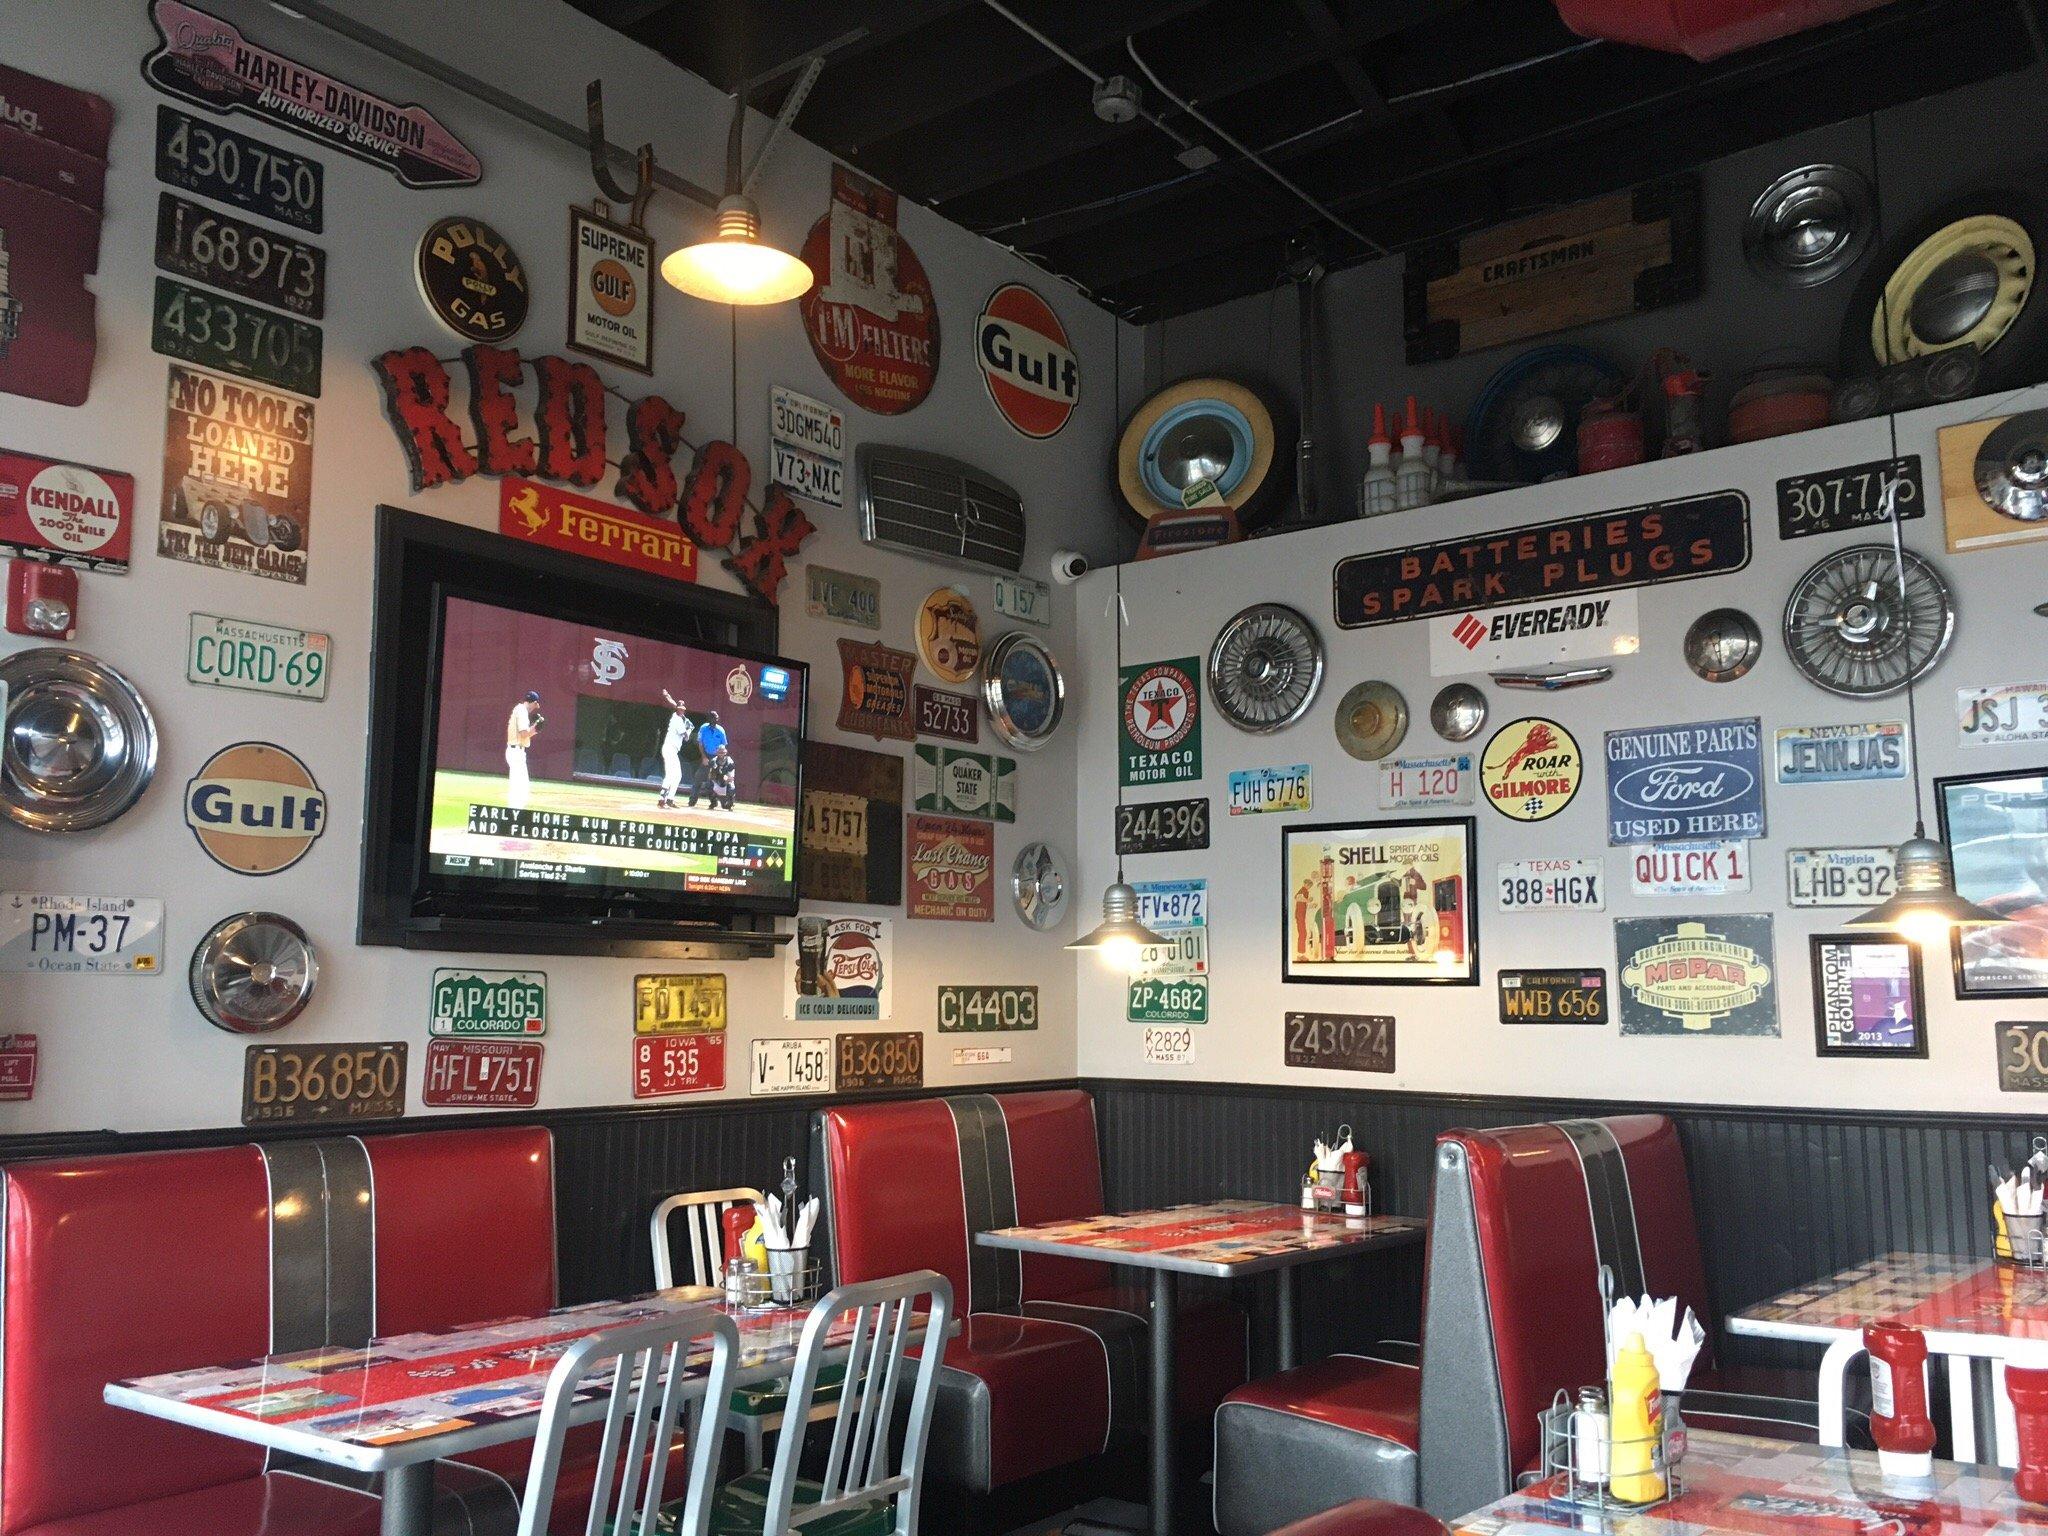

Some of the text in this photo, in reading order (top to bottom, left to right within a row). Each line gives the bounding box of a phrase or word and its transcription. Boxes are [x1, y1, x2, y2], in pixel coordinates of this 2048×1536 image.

[177, 22, 233, 53] Quality
[235, 48, 426, 150] HARLEY-DAVIDSON
[257, 86, 343, 134] AUTHORIZED
[346, 124, 402, 158] SERVICE
[432, 223, 524, 292] POLLY
[581, 226, 645, 268] SUPREME
[1482, 240, 1595, 284] CRAFTSMAN
[465, 278, 494, 294] POLLY
[593, 271, 631, 302] GULF
[451, 297, 506, 330] GAS
[587, 313, 638, 340] MOTOR OIL
[862, 323, 931, 367] FILTERS
[982, 323, 1077, 398] Gulf
[845, 364, 919, 389] MORE FLAVOR
[172, 372, 309, 442] NO TOOLS
[186, 416, 295, 465] LOANED
[777, 405, 841, 450] 3DGM540
[188, 444, 290, 498] HERE
[371, 344, 818, 606] RED SOX
[30, 486, 117, 520] KENDALL
[62, 512, 84, 523] The
[39, 517, 106, 538] 2000 MILE
[62, 532, 83, 544] OIL
[557, 504, 694, 568] Ferrari
[1400, 513, 1665, 582] BATTERIES
[1362, 538, 1714, 615] SPARK PLUGS
[1489, 600, 1611, 642] EVEREADY
[215, 625, 305, 648] MASSACHUSETTS
[1143, 687, 1180, 699] TEXACO
[923, 701, 970, 735] 52733
[1962, 696, 2019, 734] JSJ
[1608, 724, 1757, 761] GENUINE PARTS
[1810, 724, 1870, 739] NEVADA
[1994, 732, 2029, 742] ALOHA
[1129, 750, 1193, 769] TEXACO
[1398, 759, 1452, 771] Massachusetts
[1522, 754, 1572, 771] ROAR
[1783, 738, 1900, 774] JENNJAS
[953, 766, 982, 782] QUAKER
[1129, 765, 1193, 782] MOTOR OIL
[1390, 769, 1458, 797] H 120
[1533, 769, 1562, 778] with
[1641, 767, 1725, 802] Ford
[956, 781, 978, 796] STATE
[1233, 776, 1305, 805] FUH 6776
[1490, 778, 1571, 800] GILMORE
[191, 783, 323, 831] Gulf
[1119, 801, 1205, 842] 244396
[470, 804, 739, 844] EARLY HOME RUN FROM NICO POPA
[821, 807, 863, 838] 5757
[1614, 812, 1758, 838] USED HERE
[468, 820, 746, 857] AND FLORIDA STATE COULDN'T GET
[1655, 841, 1722, 852] Massachusetts
[911, 842, 991, 868] Last Chance
[1338, 843, 1439, 866] SHELL SPIRIT AND
[1389, 853, 1439, 863] MOTOR OILS
[1527, 860, 1571, 872] TEXAS
[1636, 850, 1743, 883] QUICK 1
[1827, 854, 1876, 866] Virginia
[929, 869, 972, 892] GAS
[1501, 876, 1599, 905] 388 HGX
[39, 896, 127, 912] Rhode Island
[914, 904, 988, 918] MECHANIC ON DUTY
[1171, 893, 1201, 917] 872
[31, 912, 130, 952] PM-37
[834, 920, 871, 934] ASK FOR
[39, 957, 119, 972] Ocean State
[1526, 977, 1575, 985] CALIFORNIA
[1825, 948, 1839, 1032] PHANTOM
[1837, 949, 1854, 1033] GOURMET
[438, 986, 540, 1019] GAP4965
[799, 1003, 875, 1015] ICE COLD! DELICIOUS!
[941, 989, 1036, 1029] C14403
[1145, 1010, 1189, 1018] COLORADO
[1504, 989, 1601, 1017] WWB 656
[457, 1019, 520, 1030] COLORADO
[1289, 1018, 1388, 1057] 243024
[1858, 1031, 1882, 1041] 2013
[462, 1044, 513, 1055] MISSOURI
[665, 1036, 697, 1049] IOWA
[1154, 1031, 1191, 1052] 2829
[664, 1048, 699, 1077] 535
[787, 1051, 824, 1083] 1458
[841, 1038, 920, 1076] B36850
[253, 1050, 400, 1104] B36850
[430, 1056, 534, 1093] HFL 751
[451, 1094, 514, 1102] SHOW-ME STATE
